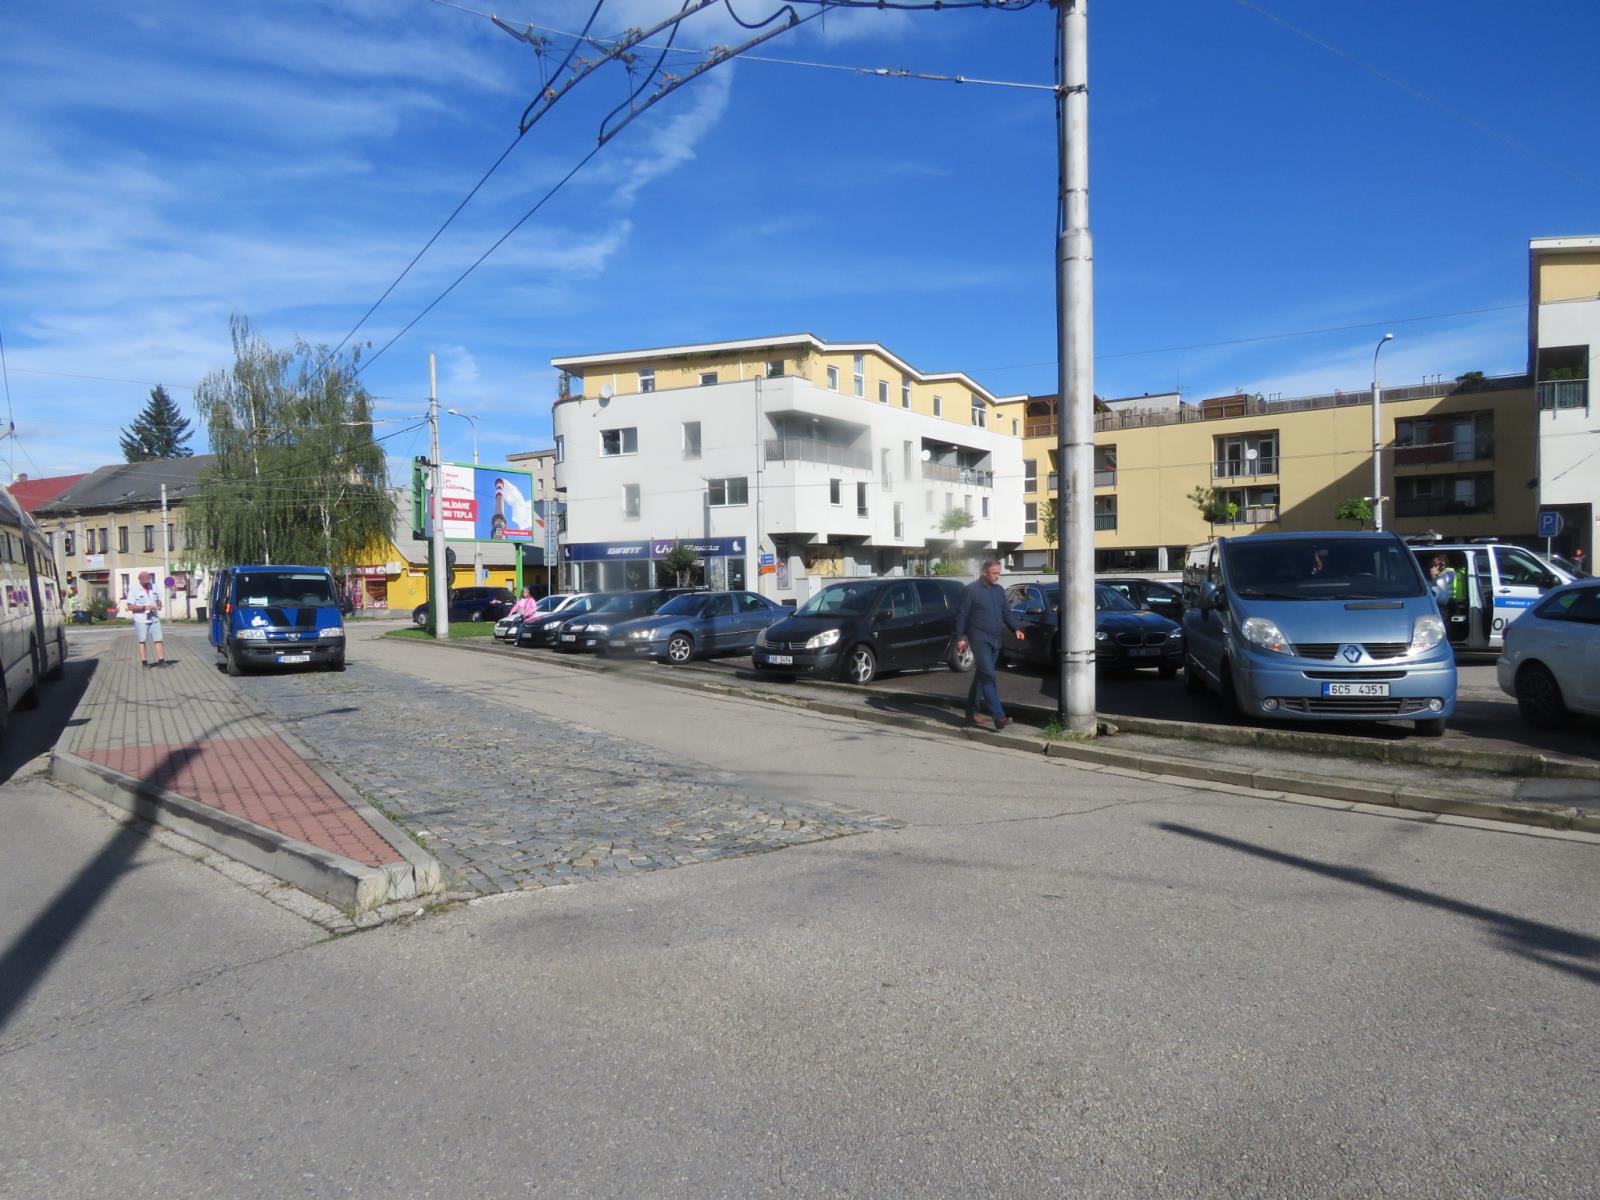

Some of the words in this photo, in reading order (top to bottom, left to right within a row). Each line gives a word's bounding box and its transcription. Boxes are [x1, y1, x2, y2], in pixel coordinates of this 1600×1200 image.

[1543, 515, 1553, 530] P
[1331, 684, 1351, 695] 6C5
[1358, 684, 1384, 695] 4351
